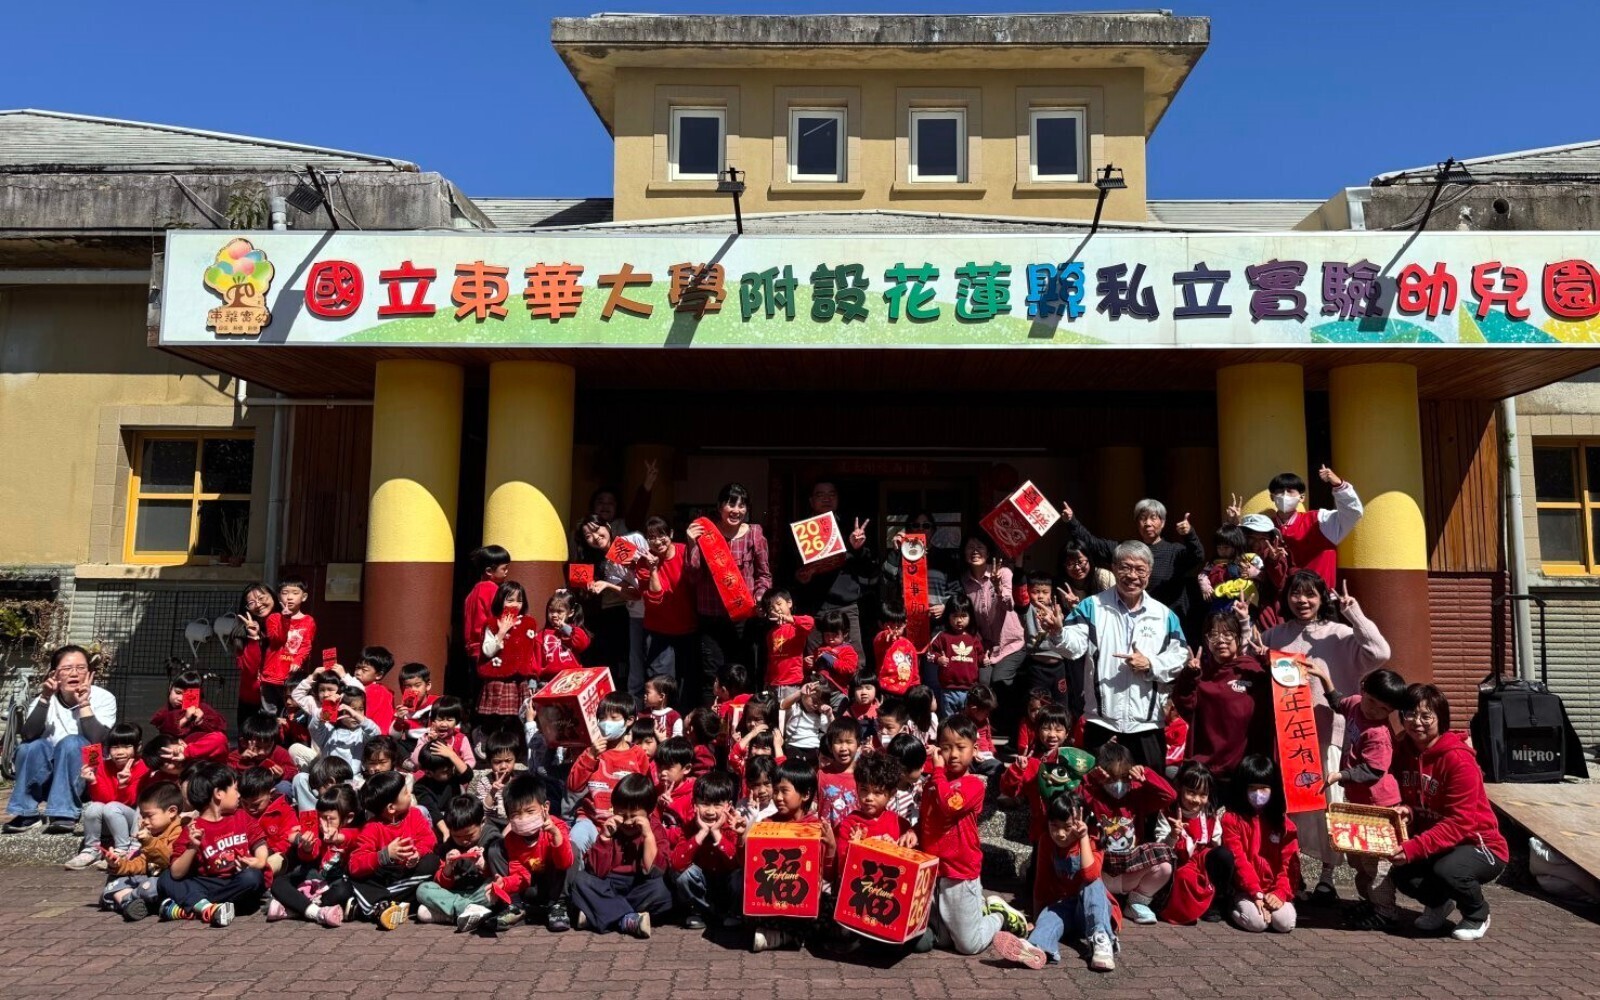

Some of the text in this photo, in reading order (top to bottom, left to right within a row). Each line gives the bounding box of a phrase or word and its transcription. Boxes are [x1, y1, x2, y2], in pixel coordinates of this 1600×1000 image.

[305, 259, 1600, 321] 國立東華大學附設花蓮縣私立實驗幼兒園
[754, 848, 809, 905] 福
[848, 859, 901, 925] 福
